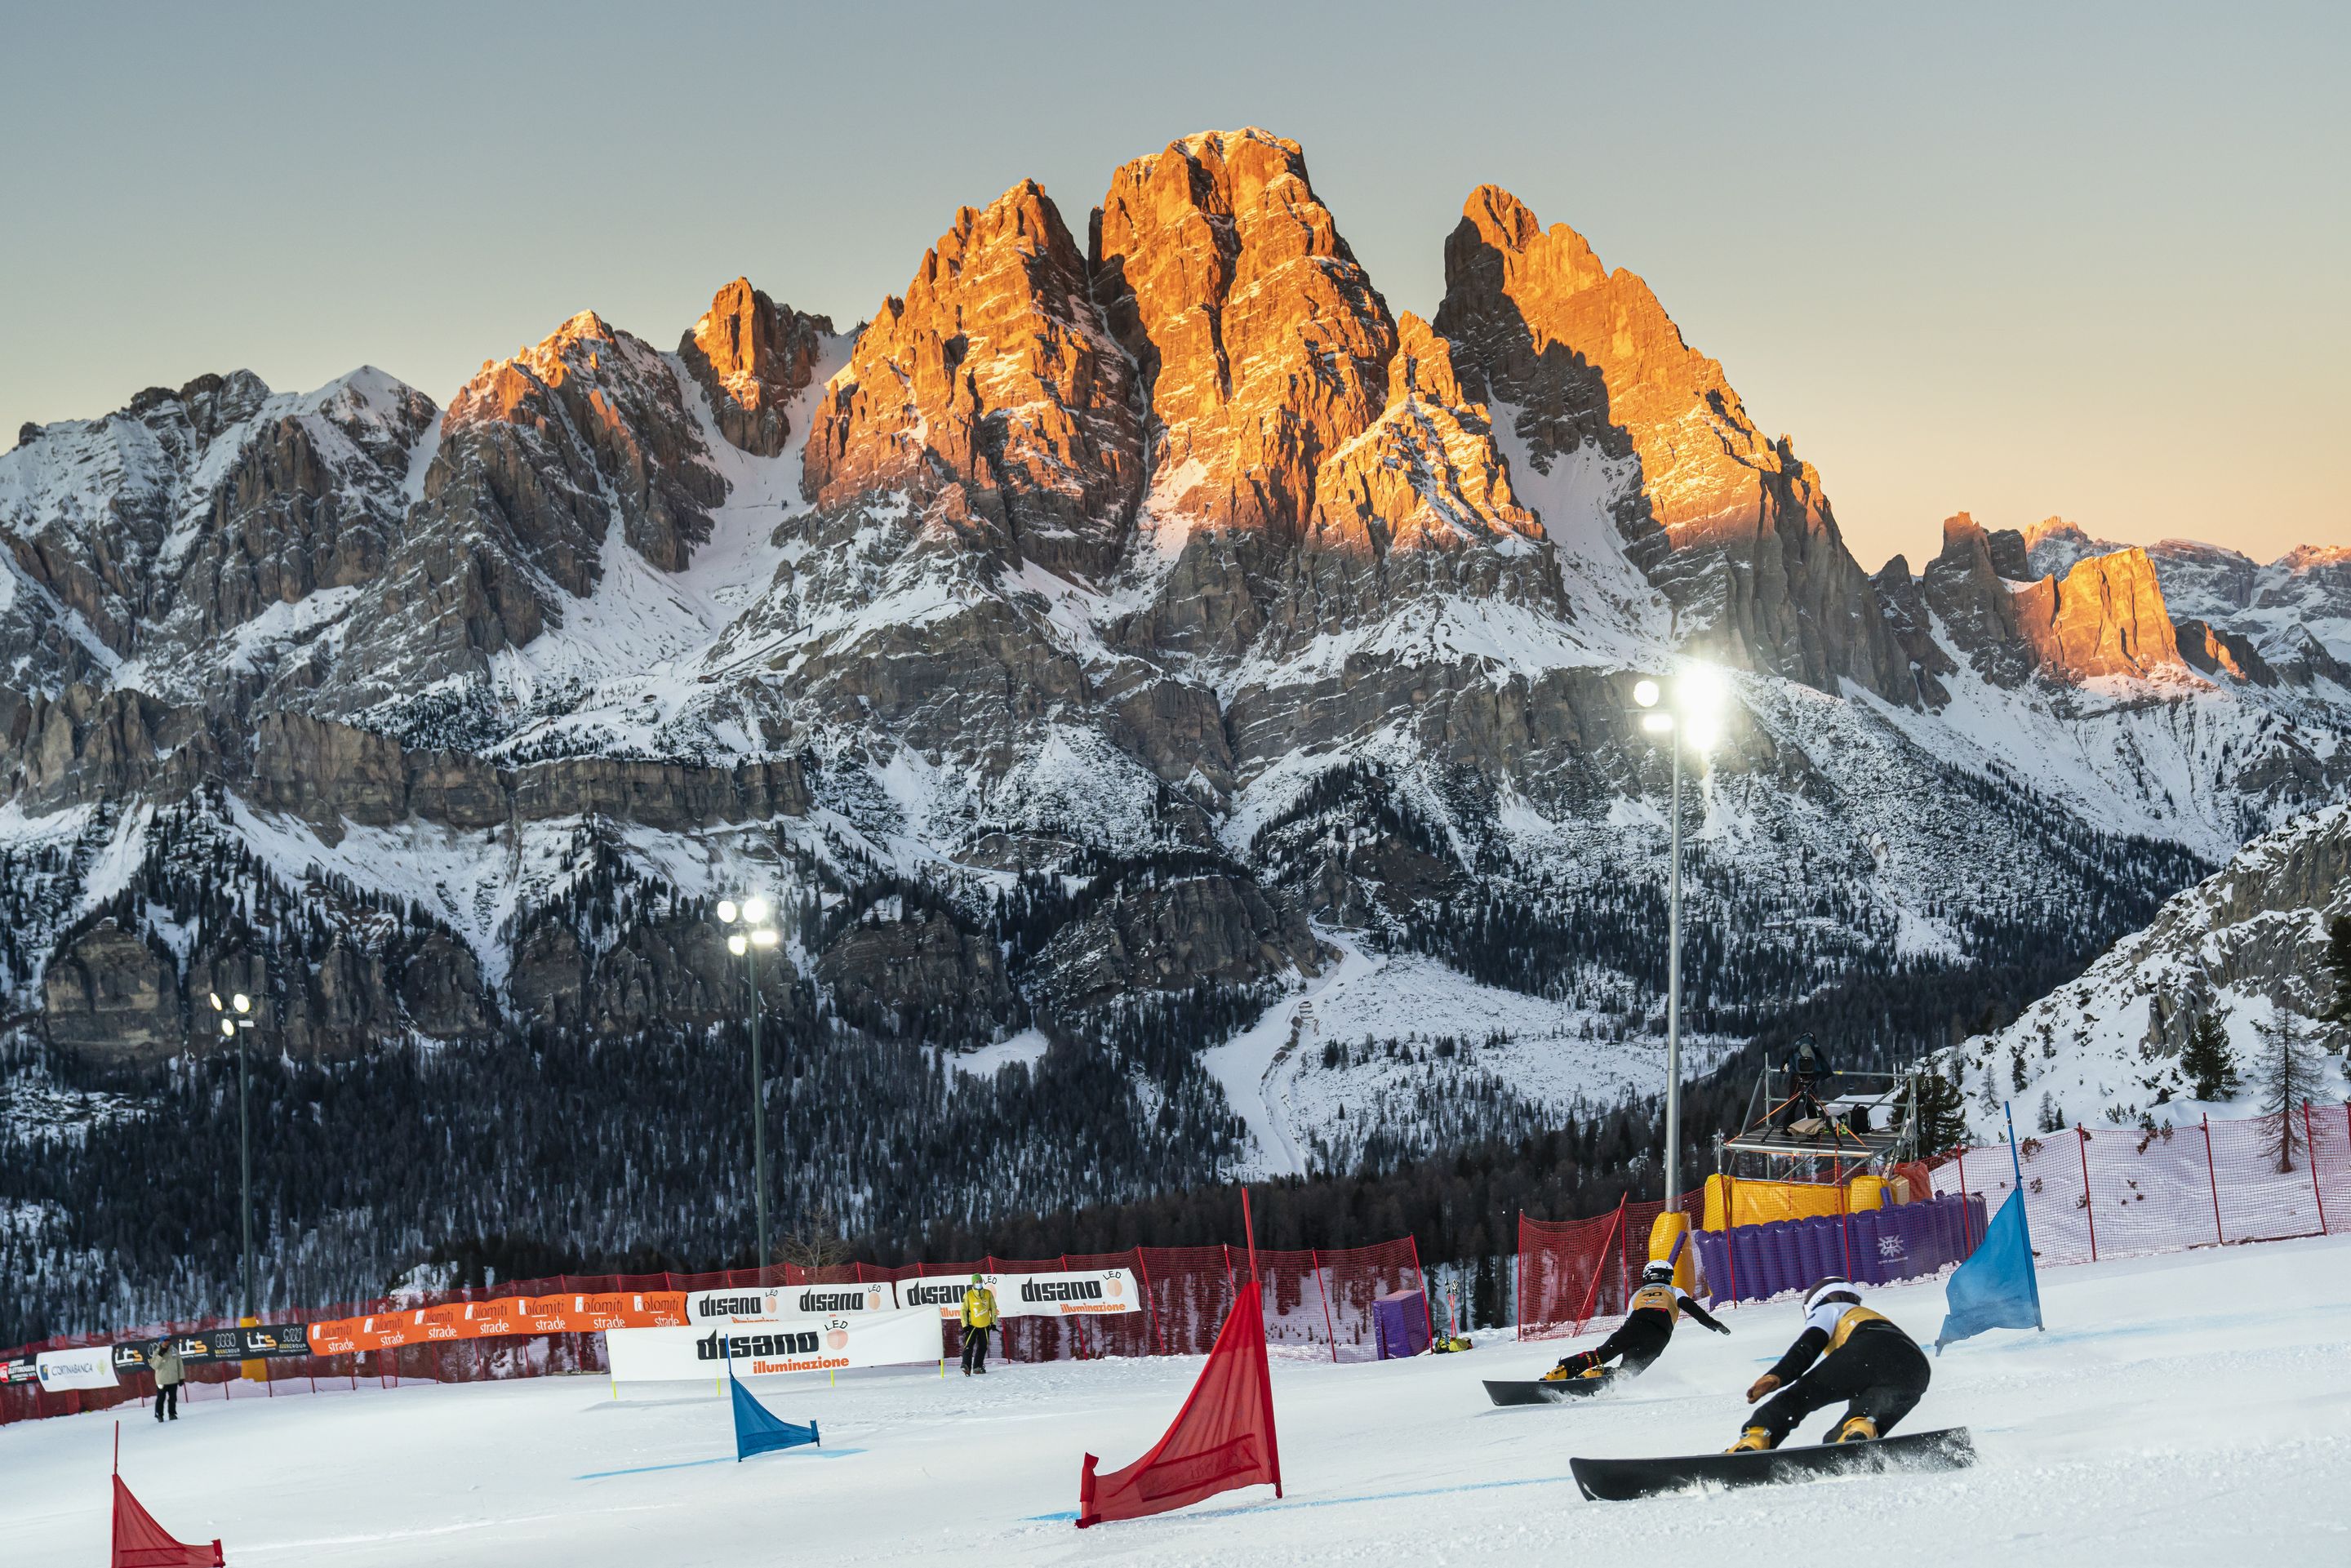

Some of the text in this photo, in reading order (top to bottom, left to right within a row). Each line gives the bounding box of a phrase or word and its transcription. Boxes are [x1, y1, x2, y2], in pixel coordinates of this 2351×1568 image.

[984, 1276, 997, 1285] LED
[1103, 1271, 1121, 1281] LED
[868, 1284, 881, 1293] LED
[907, 1281, 975, 1306] disan
[1021, 1277, 1102, 1302] disano
[700, 1293, 762, 1317] disano
[799, 1288, 864, 1312] disano
[1060, 1303, 1126, 1313] illuminazione
[480, 1320, 509, 1334] strade
[536, 1316, 566, 1330] strade
[593, 1315, 626, 1329] strade
[654, 1314, 679, 1326] strade
[824, 1319, 848, 1331] LED
[380, 1332, 404, 1346] strade
[429, 1325, 457, 1339] strade
[328, 1339, 354, 1353] strade
[696, 1329, 819, 1361] disano
[753, 1356, 849, 1375] illuminazione
